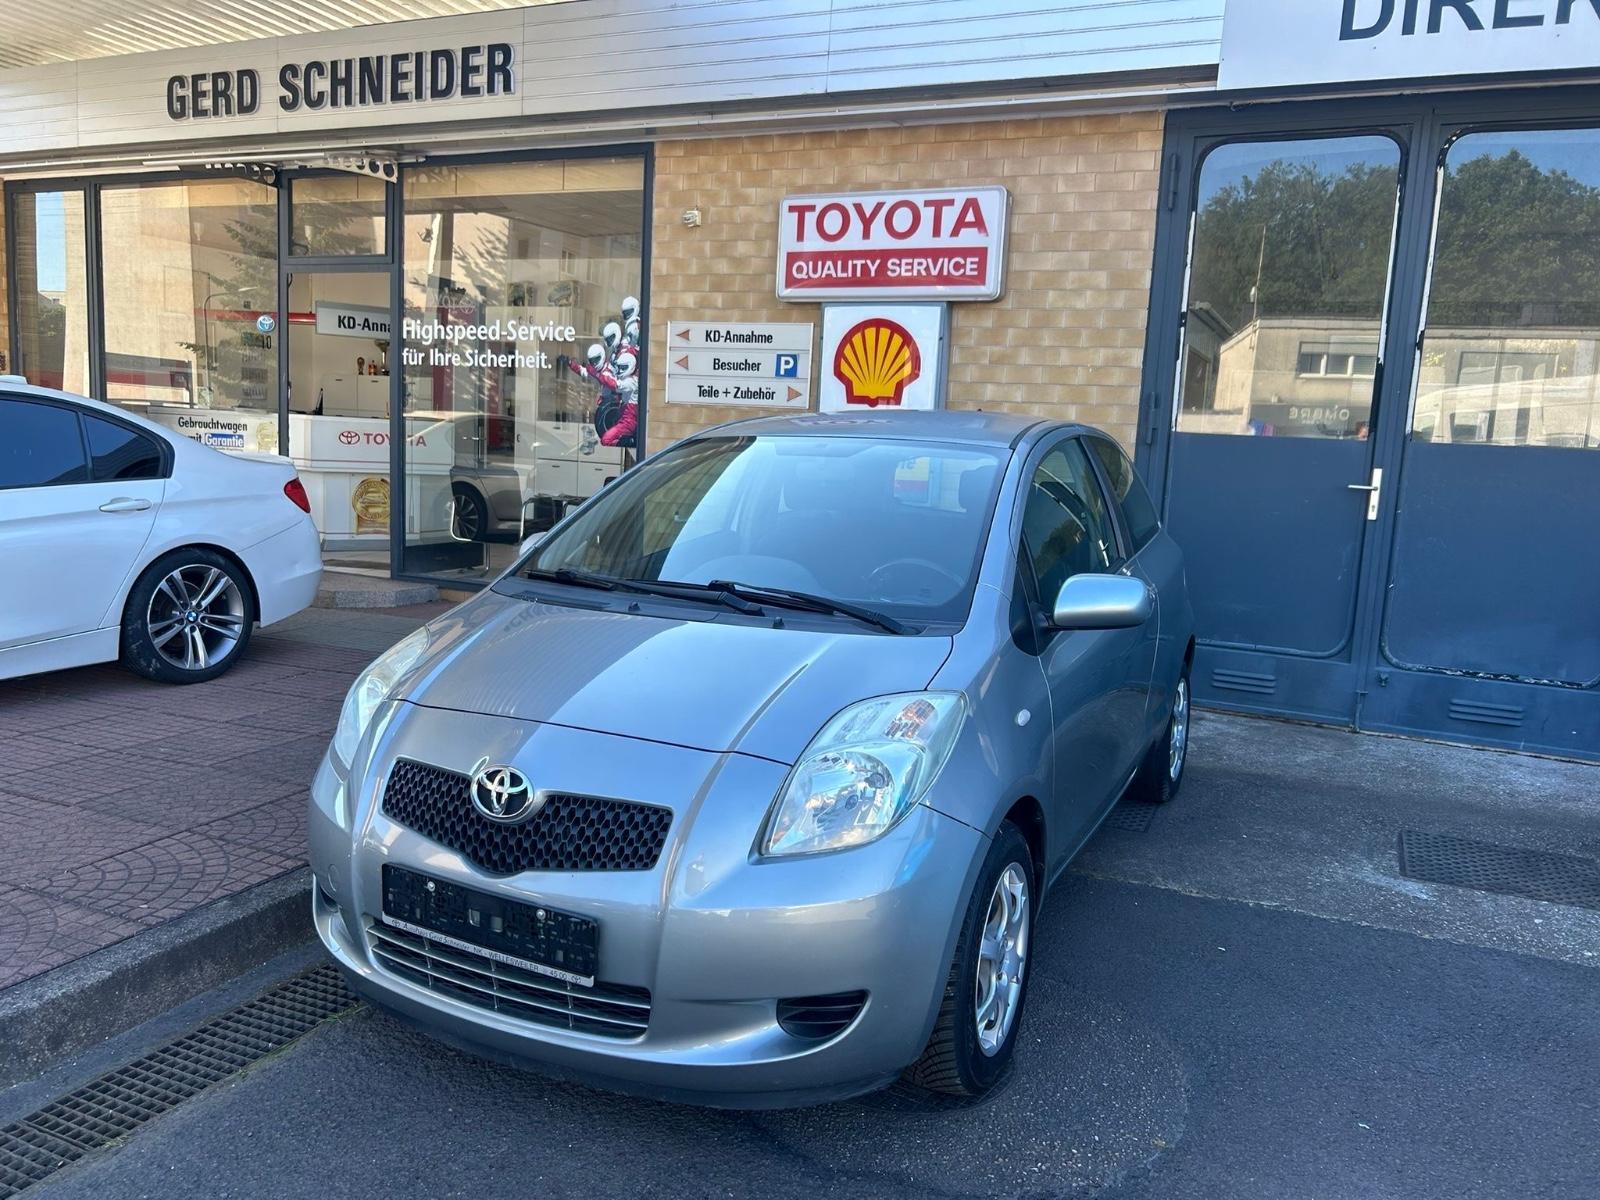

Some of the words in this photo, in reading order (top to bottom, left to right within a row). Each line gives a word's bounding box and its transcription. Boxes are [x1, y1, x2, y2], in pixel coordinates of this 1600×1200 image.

[166, 68, 260, 120] GERD
[278, 42, 514, 112] SCHNEIDER
[788, 197, 989, 242] TOYOTA
[792, 259, 880, 279] QUALITY
[886, 257, 979, 277] SERVICE
[402, 319, 576, 345] Highspeed-Service
[705, 330, 773, 344] KD-Annahme
[402, 348, 425, 366] für
[430, 349, 461, 367] Ihre
[465, 350, 552, 369] Sicherheit.
[713, 358, 761, 372] Besucher
[697, 385, 719, 398] Teile
[733, 386, 776, 400] Zubehör
[178, 416, 247, 433] Gebrauchtwagen
[205, 434, 244, 447] Garantie
[364, 432, 427, 447] TOTA
